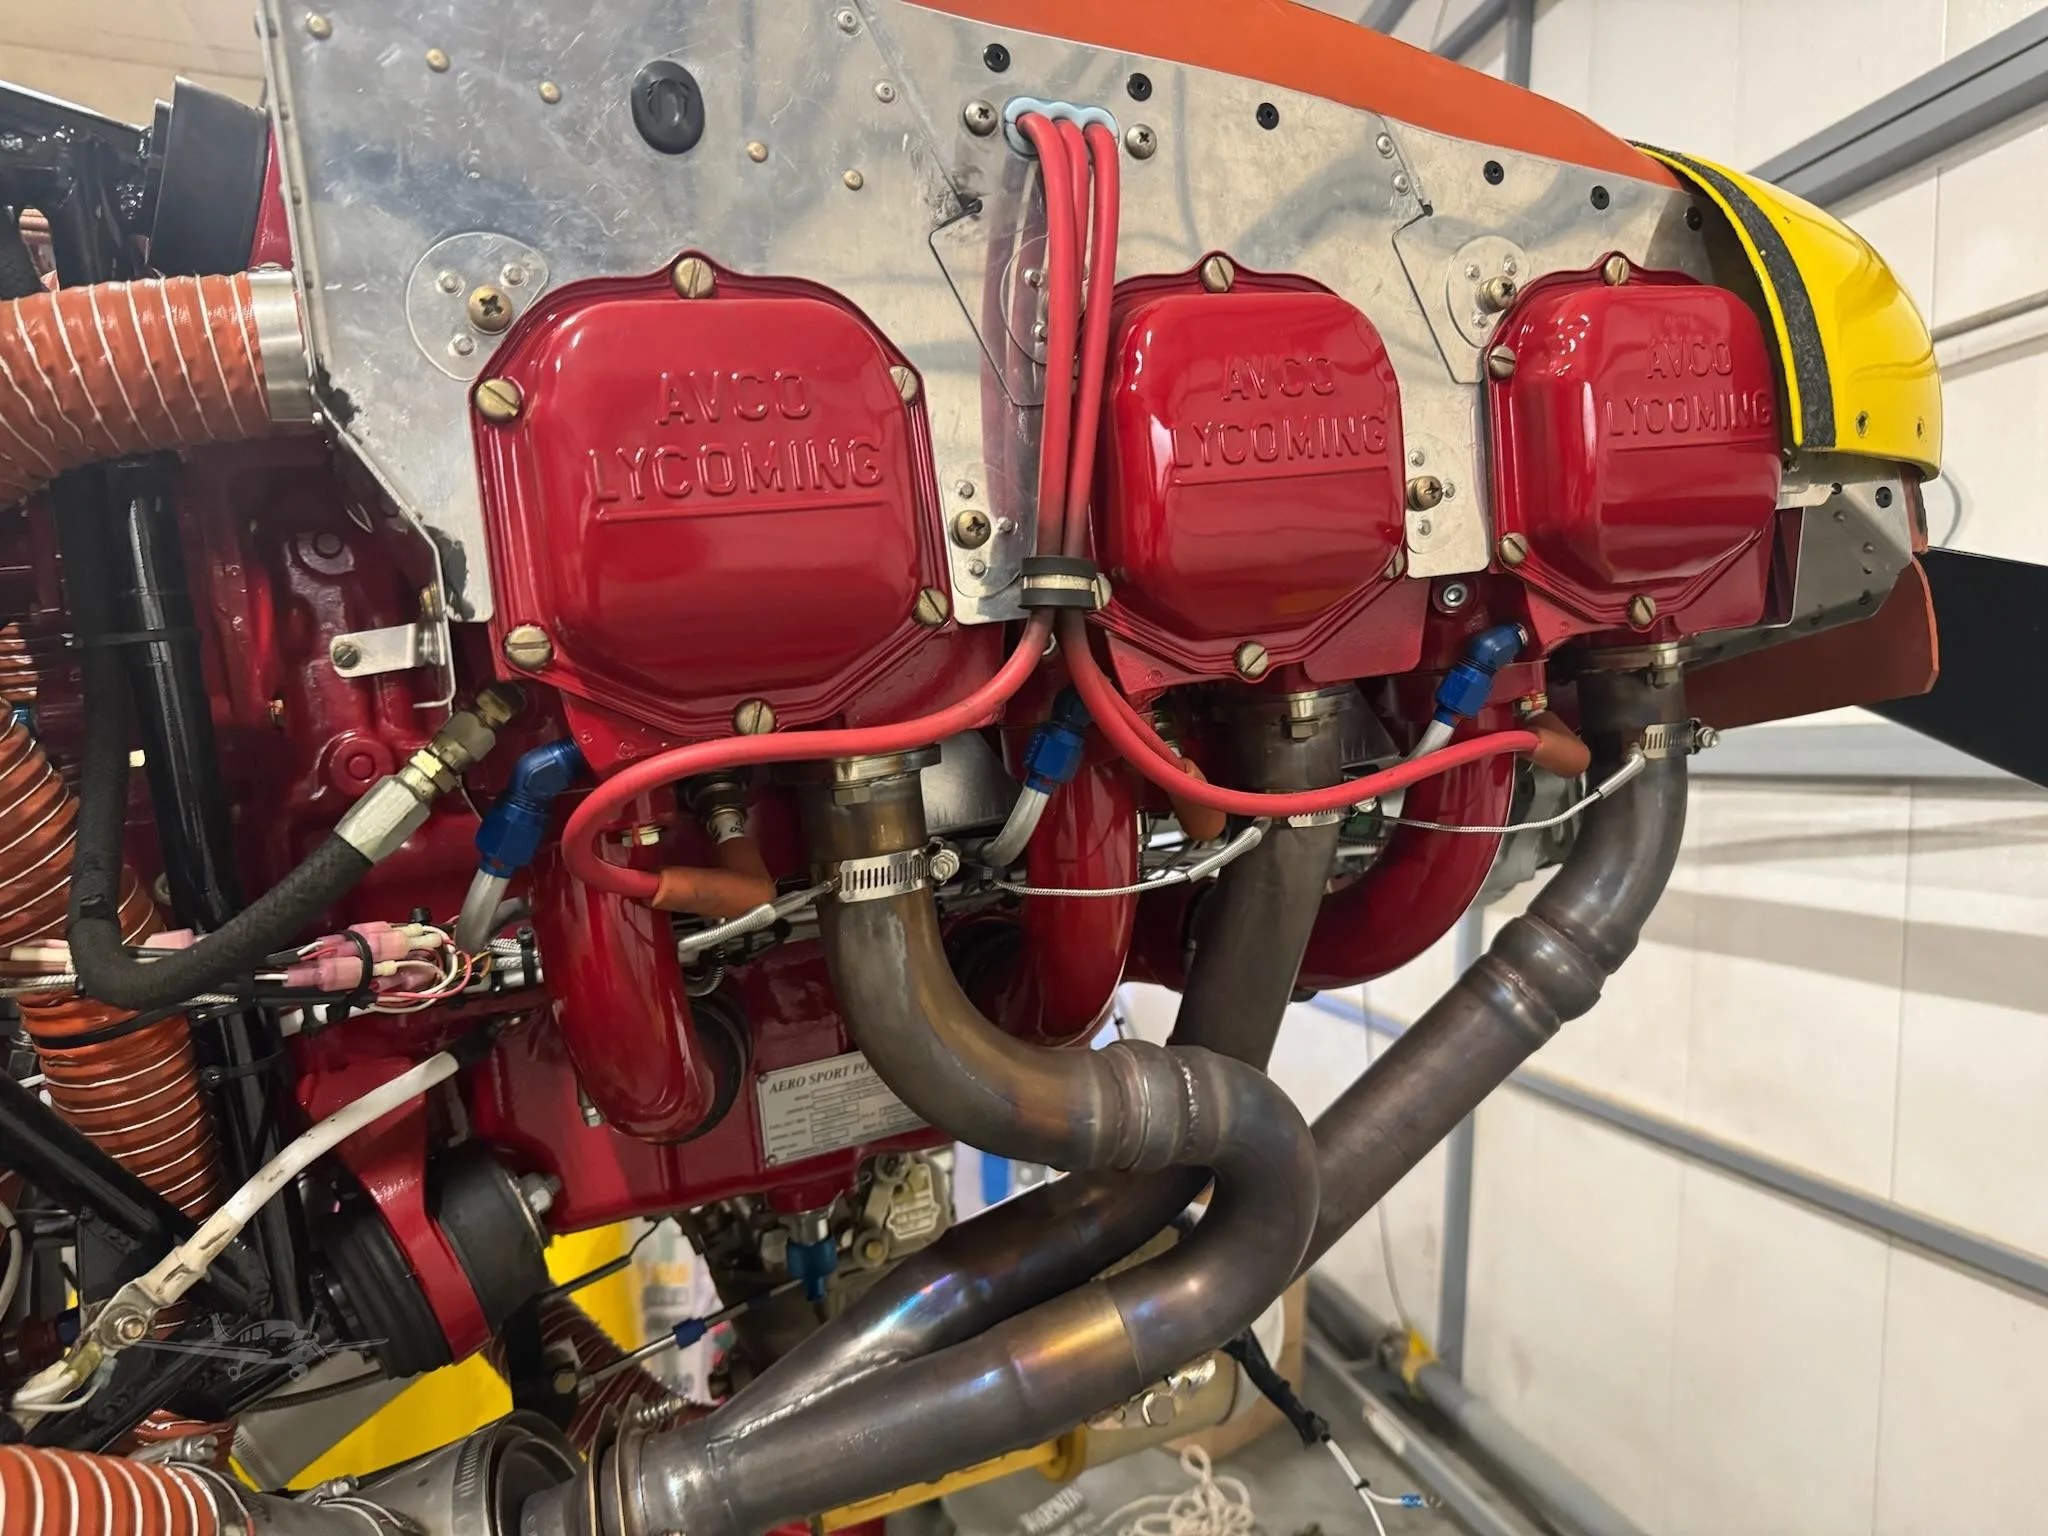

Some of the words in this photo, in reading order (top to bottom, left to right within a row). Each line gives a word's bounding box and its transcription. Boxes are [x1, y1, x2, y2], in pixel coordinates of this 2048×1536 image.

[1220, 353, 1335, 402] AVCO
[1647, 338, 1733, 379] AVCO
[654, 367, 811, 426] AVCO
[1604, 389, 1771, 437] LYCOMING
[1170, 412, 1388, 468] LYCOMING
[586, 436, 883, 503] LYCOMING
[768, 1076, 807, 1095] AERO
[809, 1066, 850, 1085] SPORT
